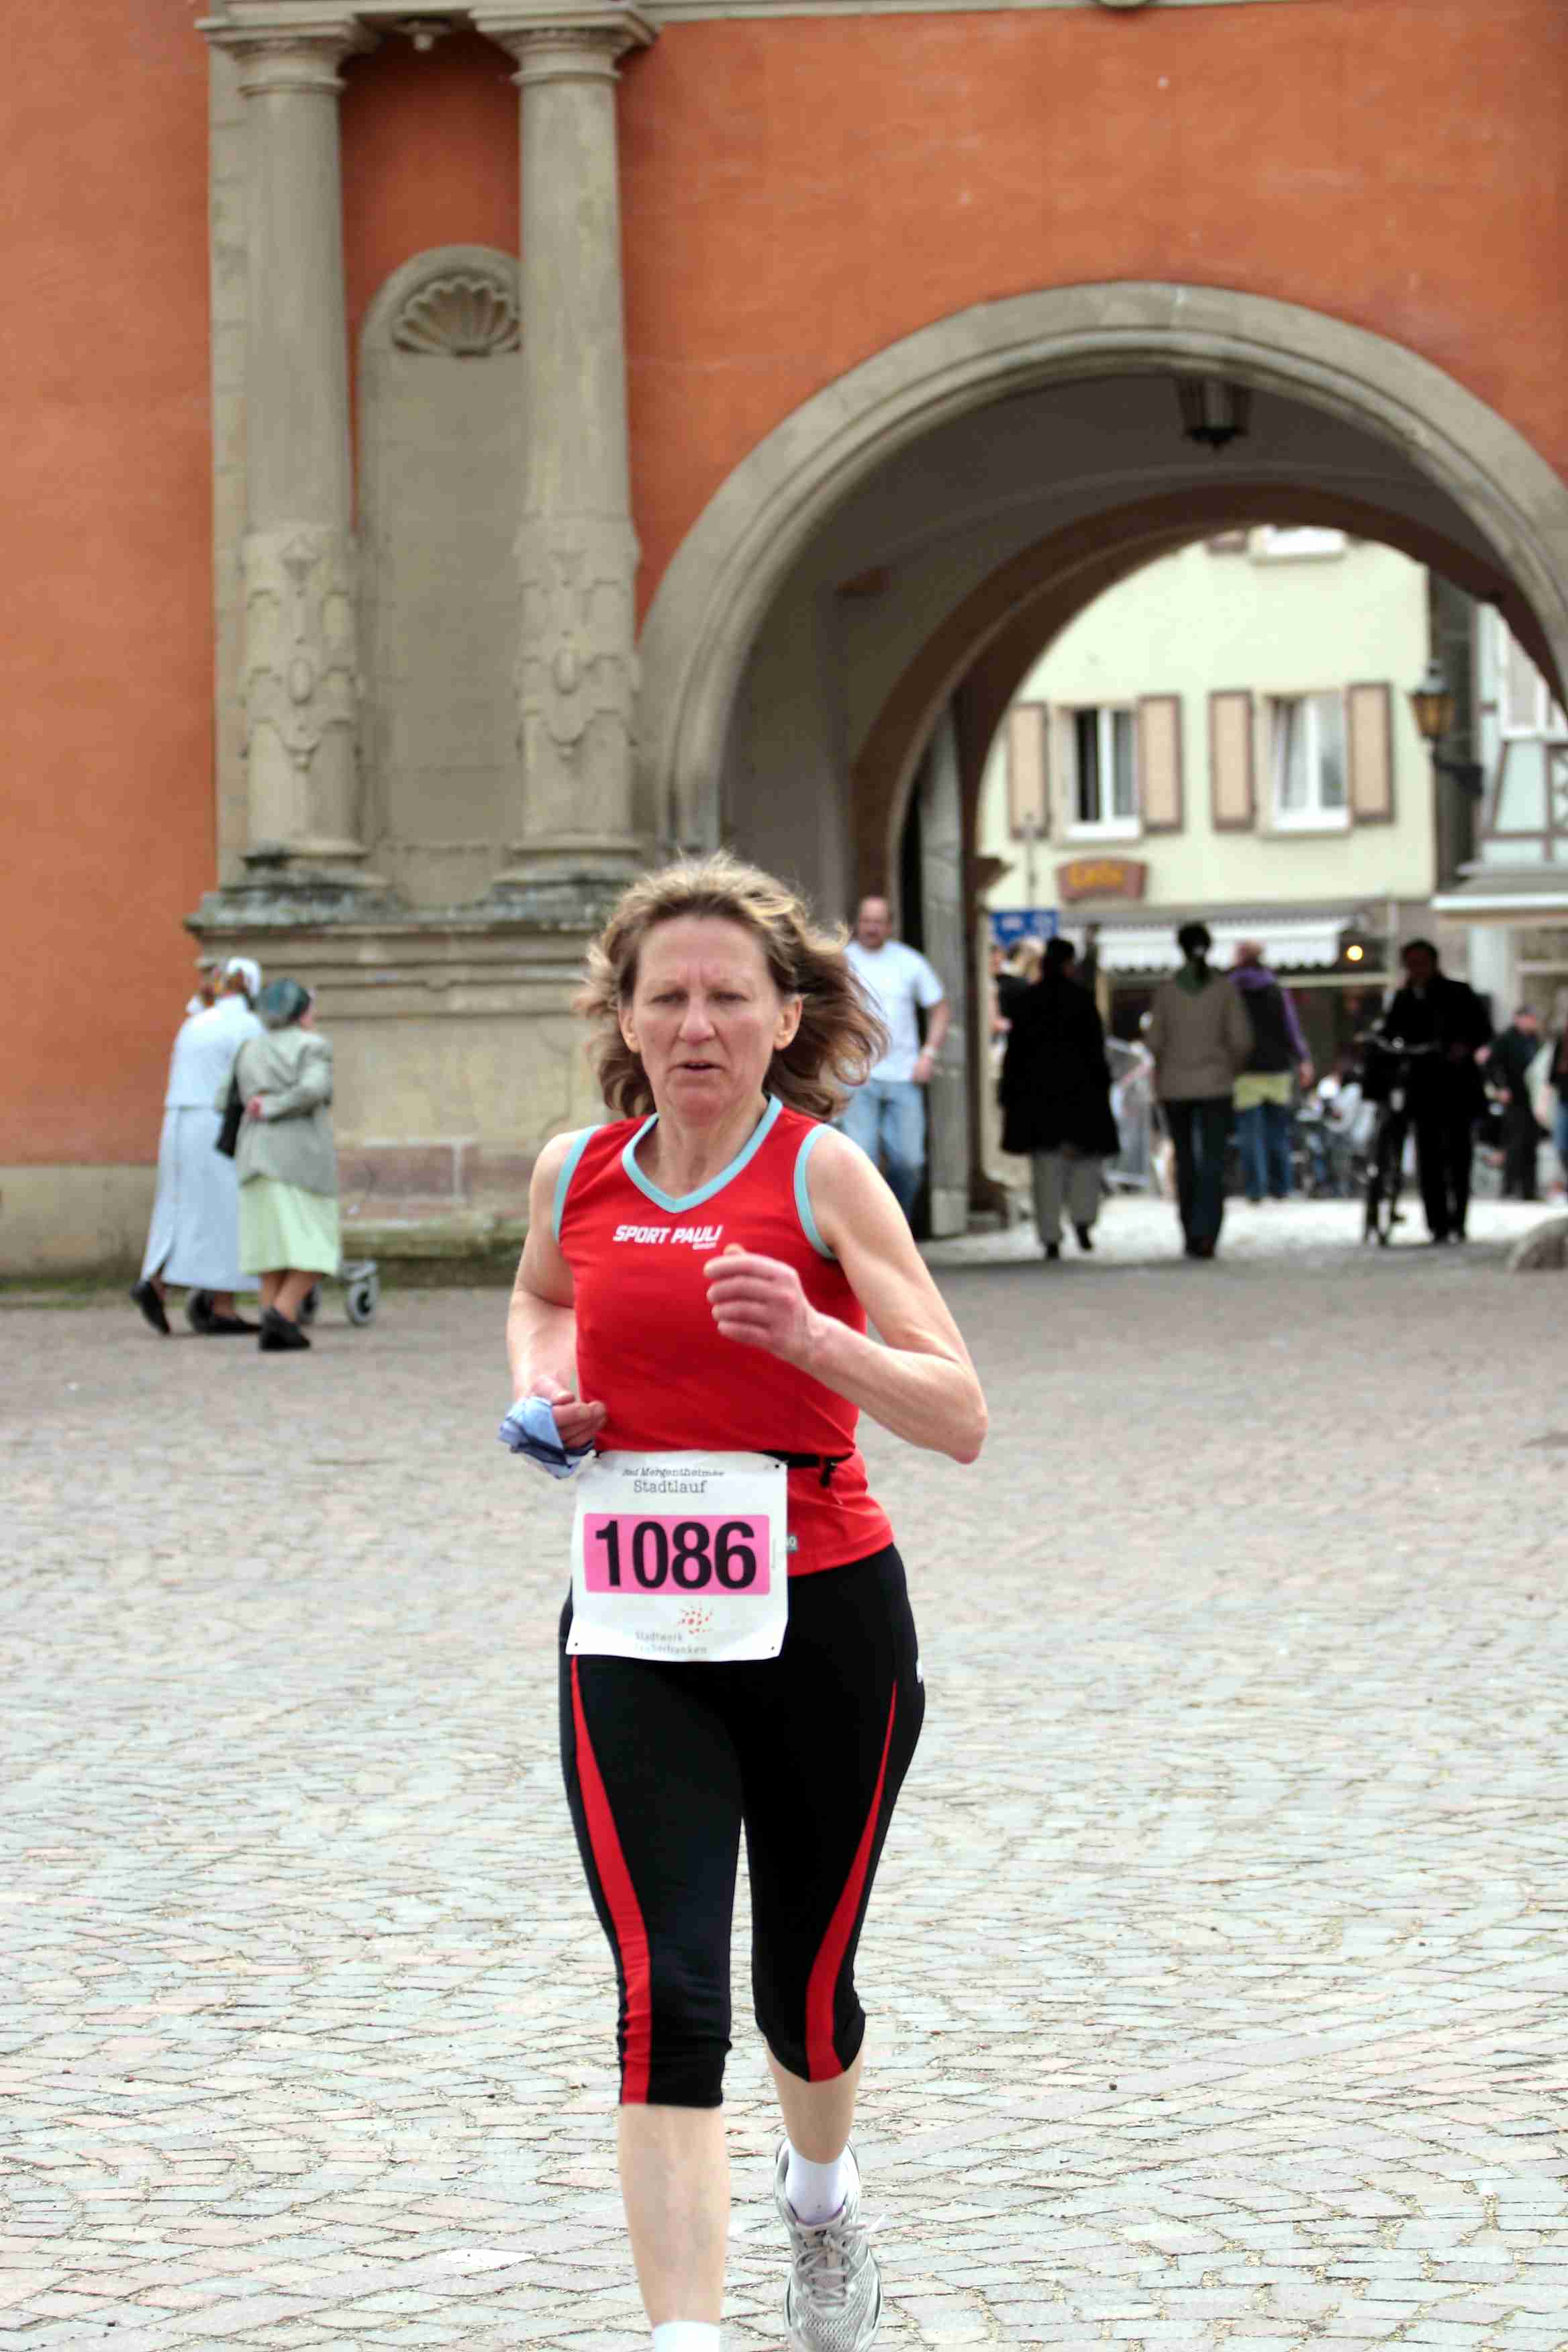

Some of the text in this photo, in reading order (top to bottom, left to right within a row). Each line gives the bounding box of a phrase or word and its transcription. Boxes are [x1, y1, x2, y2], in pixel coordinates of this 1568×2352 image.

[613, 1224, 671, 1244] SPORT
[634, 1479, 708, 1493] Stadtlauf
[595, 1520, 756, 1589] 1086
